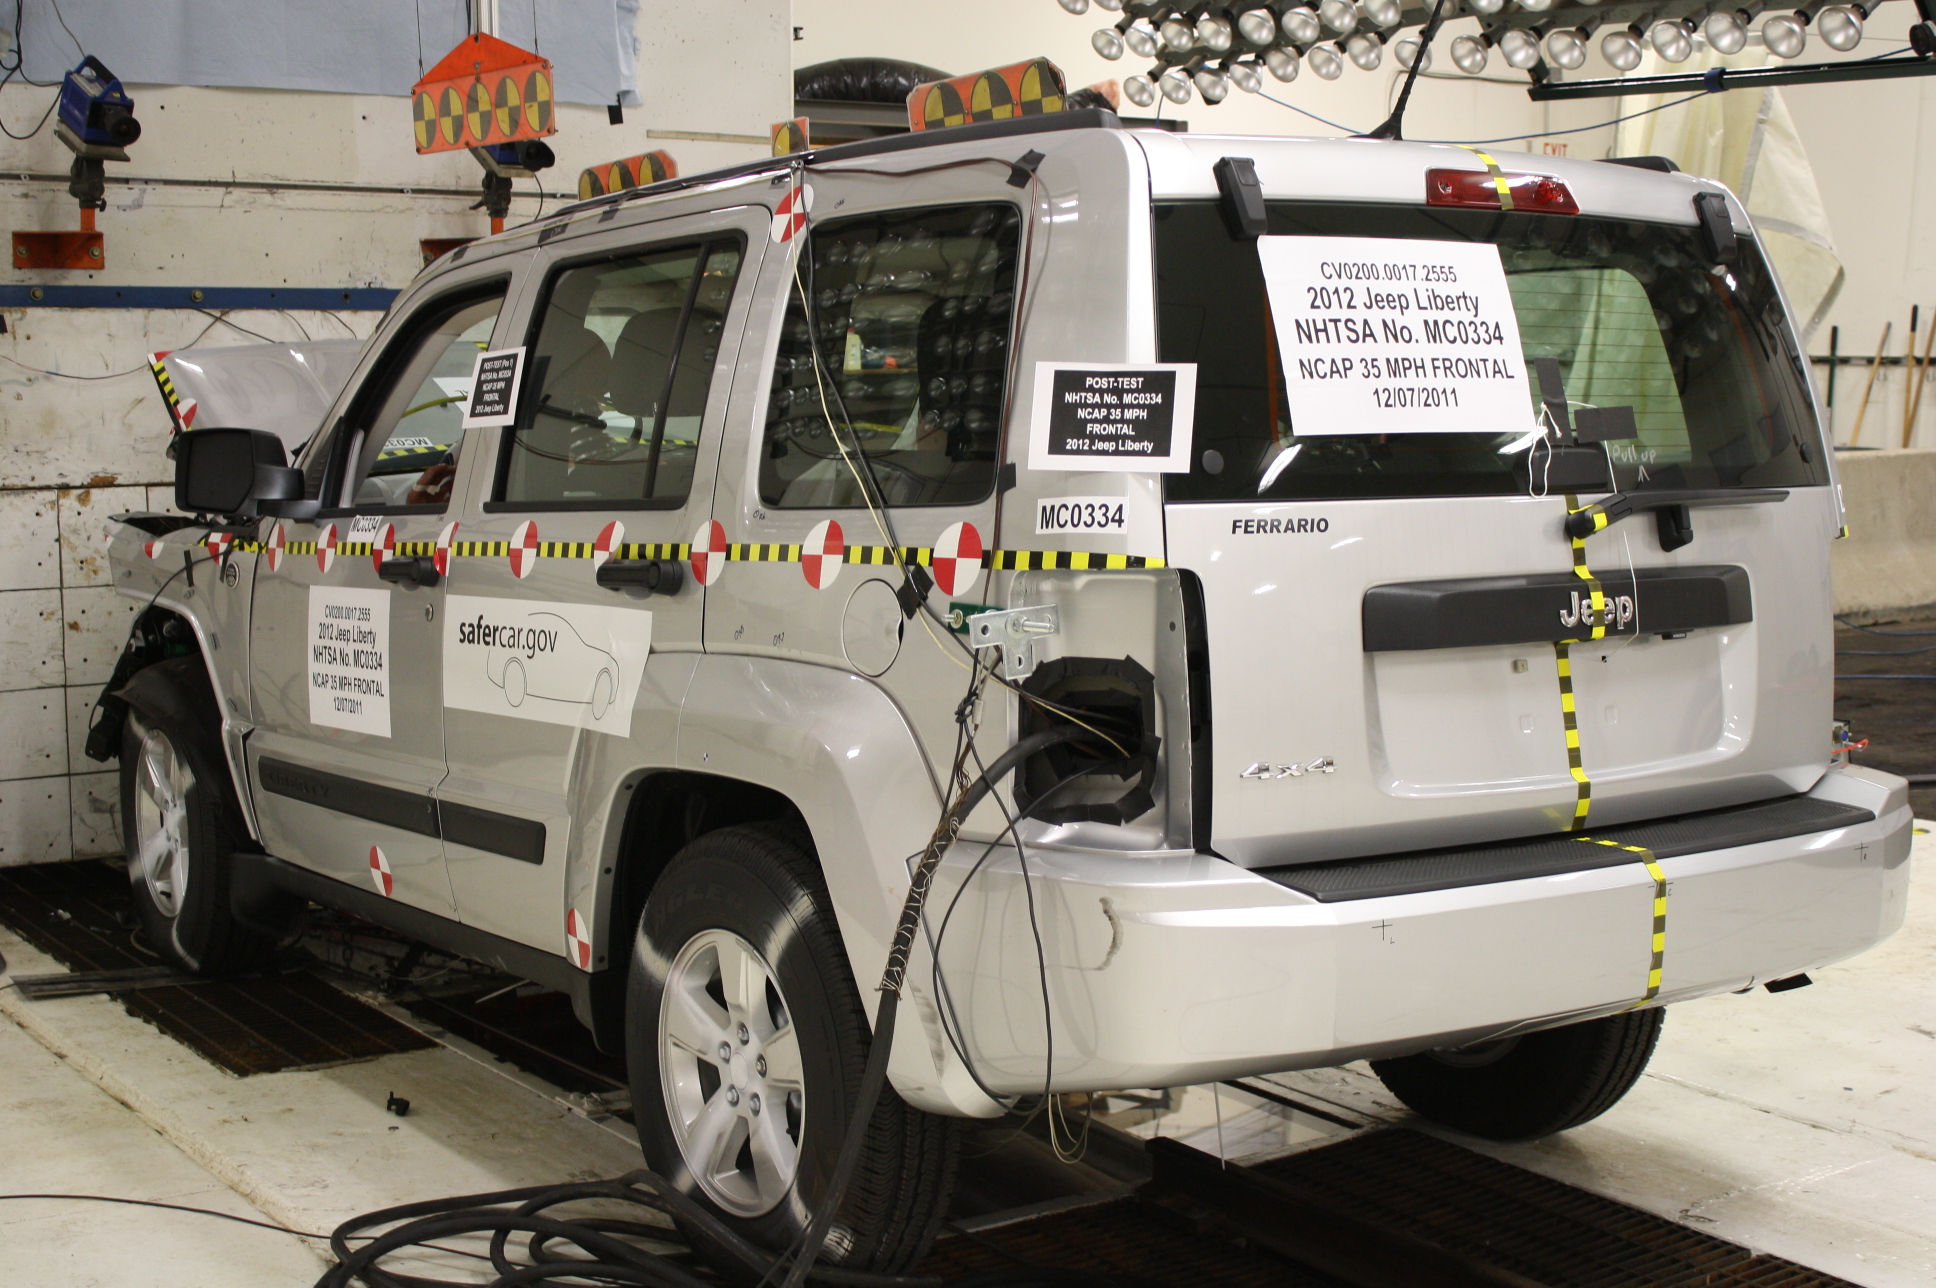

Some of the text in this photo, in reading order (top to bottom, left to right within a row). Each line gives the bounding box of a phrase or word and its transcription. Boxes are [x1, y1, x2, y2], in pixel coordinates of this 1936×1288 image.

[1320, 261, 1457, 283] CV0200.0017.2555
[1307, 286, 1479, 318] 2012 Jeep Liberty
[1294, 318, 1504, 345] NHTSA No. MC0334
[1298, 357, 1515, 380] NCAP 35 MPH FRONTAL
[1085, 377, 1144, 389] POST-TEST
[1065, 392, 1162, 404] NHTSA No. MC0334
[1373, 387, 1459, 408] 12/07/2011
[1077, 408, 1147, 419] NCAP 35 MPH
[1086, 424, 1135, 435] FRONTAL
[1066, 439, 1153, 454] 2012 Jeep Liberty
[1641, 449, 1656, 464] up
[351, 517, 380, 532] MC0334
[1041, 503, 1124, 529] MC0334
[1231, 518, 1329, 534] FERRARIO
[325, 604, 371, 622] CV0200.0017.2555
[1560, 591, 1634, 630] Jeep
[318, 622, 376, 649] 2012 Jeep Liberty
[459, 614, 558, 659] safercar.gov
[313, 644, 383, 671] NHTSA No. MC0334
[312, 671, 384, 697] NCAP 35 MPH FRONTAL
[333, 696, 363, 715] 12/07/2011
[1240, 756, 1338, 780] 4x4
